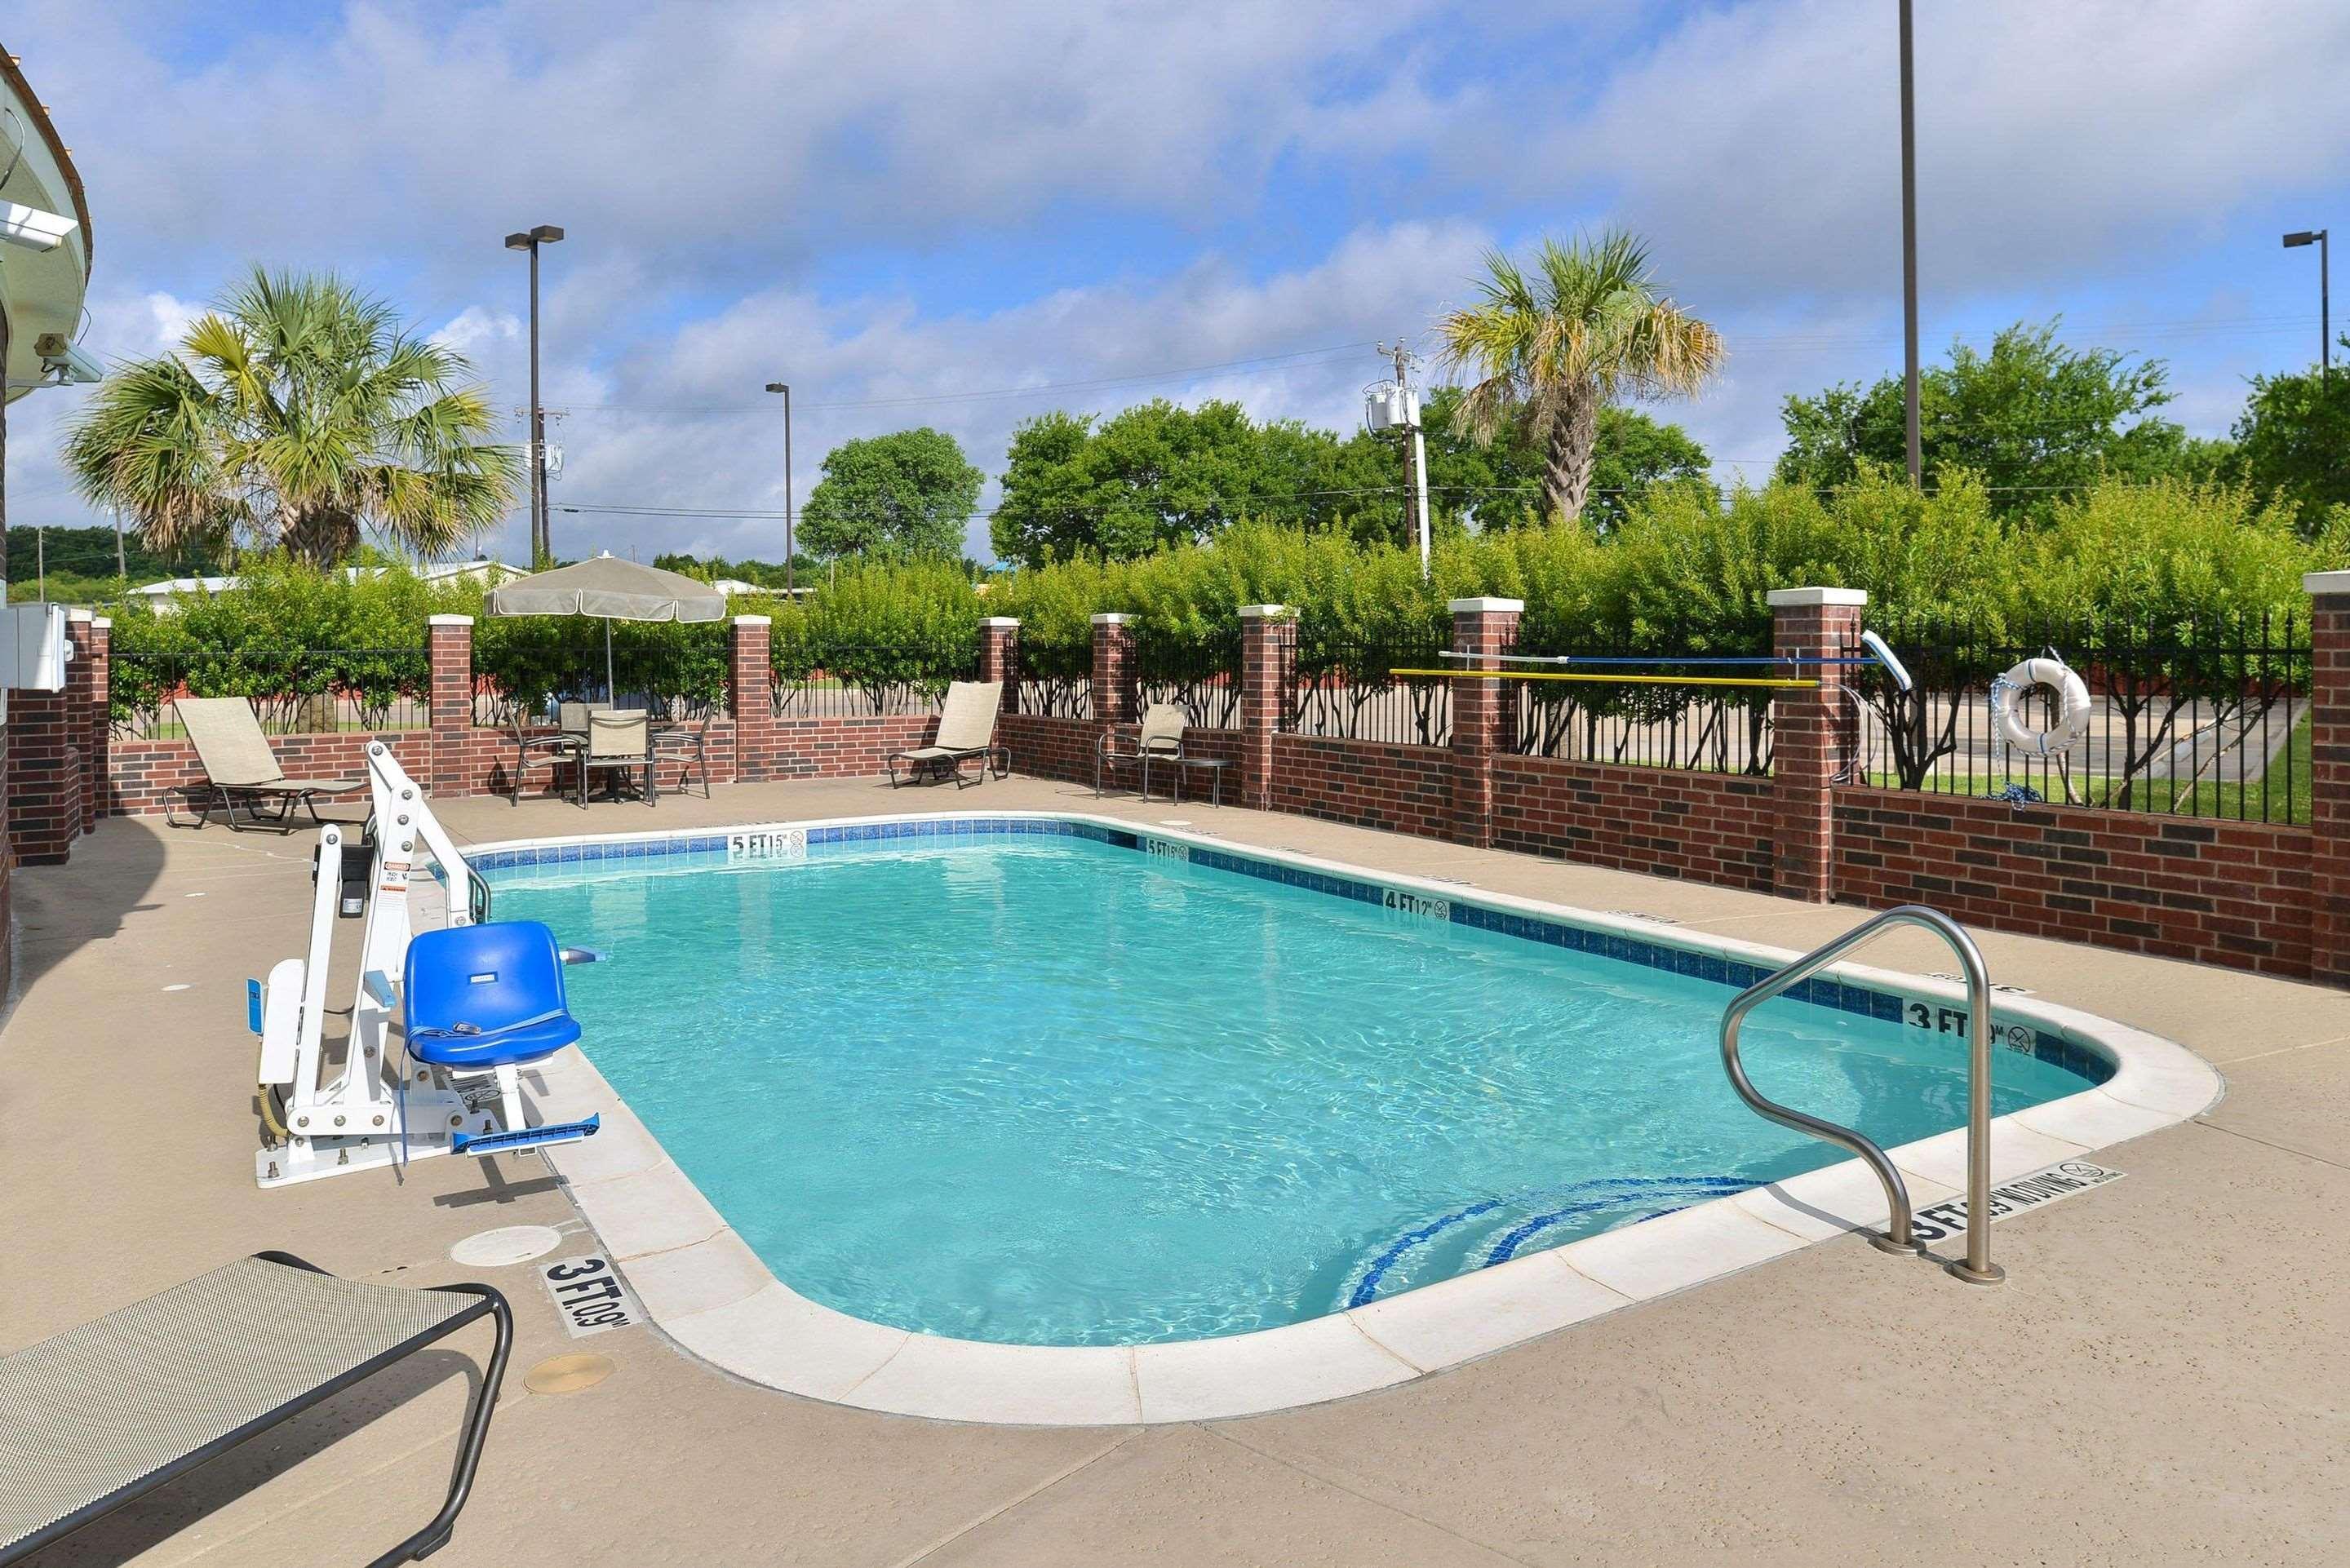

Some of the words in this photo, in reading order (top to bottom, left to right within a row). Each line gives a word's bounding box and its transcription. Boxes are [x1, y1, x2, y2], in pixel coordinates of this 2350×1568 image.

[1385, 891, 1397, 909] 4
[1908, 1003, 1931, 1030] 3
[547, 1259, 605, 1281] 3
